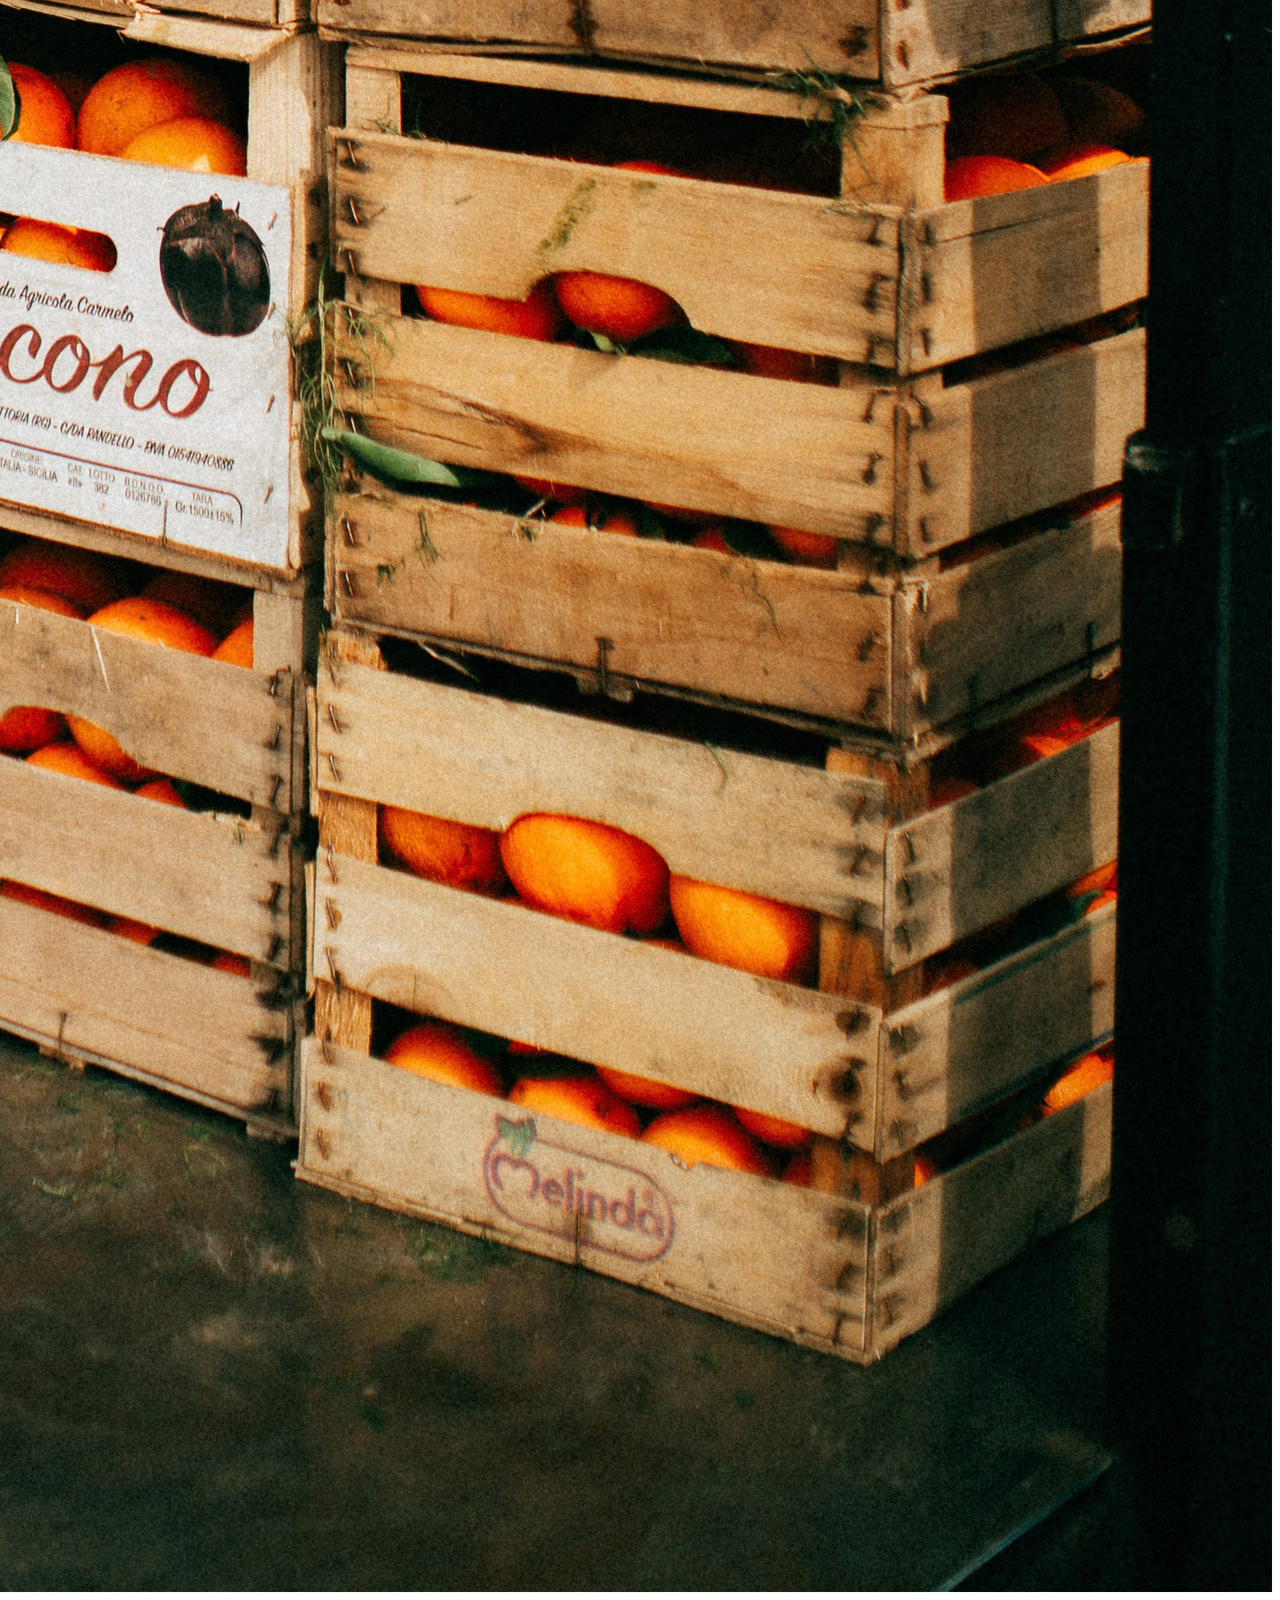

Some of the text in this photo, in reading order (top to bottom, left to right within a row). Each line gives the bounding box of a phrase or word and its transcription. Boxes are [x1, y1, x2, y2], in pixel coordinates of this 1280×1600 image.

[19, 284, 75, 312] Agricola
[76, 296, 135, 323] Carmelo
[31, 414, 52, 431] (RG)
[59, 420, 85, 438] C/DA
[86, 427, 135, 450] RANDELLO
[28, 465, 58, 483] SICILIA
[489, 1153, 665, 1238] Melinda
